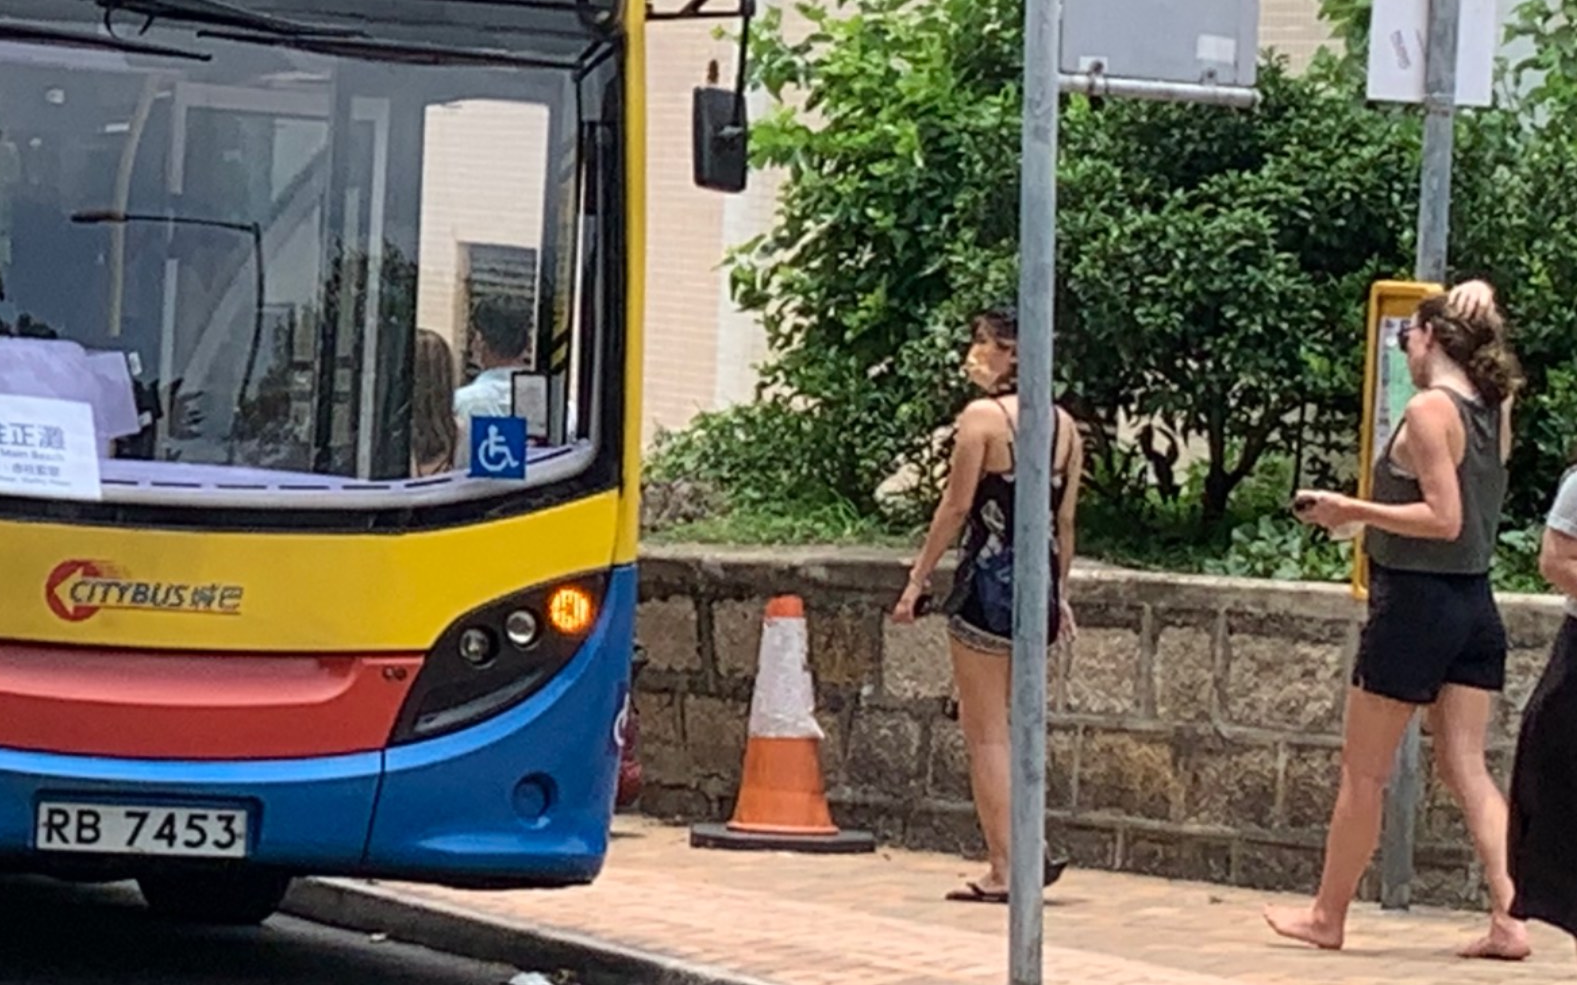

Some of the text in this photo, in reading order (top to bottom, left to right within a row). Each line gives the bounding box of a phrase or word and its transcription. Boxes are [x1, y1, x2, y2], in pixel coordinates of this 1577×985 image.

[69, 580, 189, 608] CITYBUS
[45, 807, 237, 850] RB 7453
